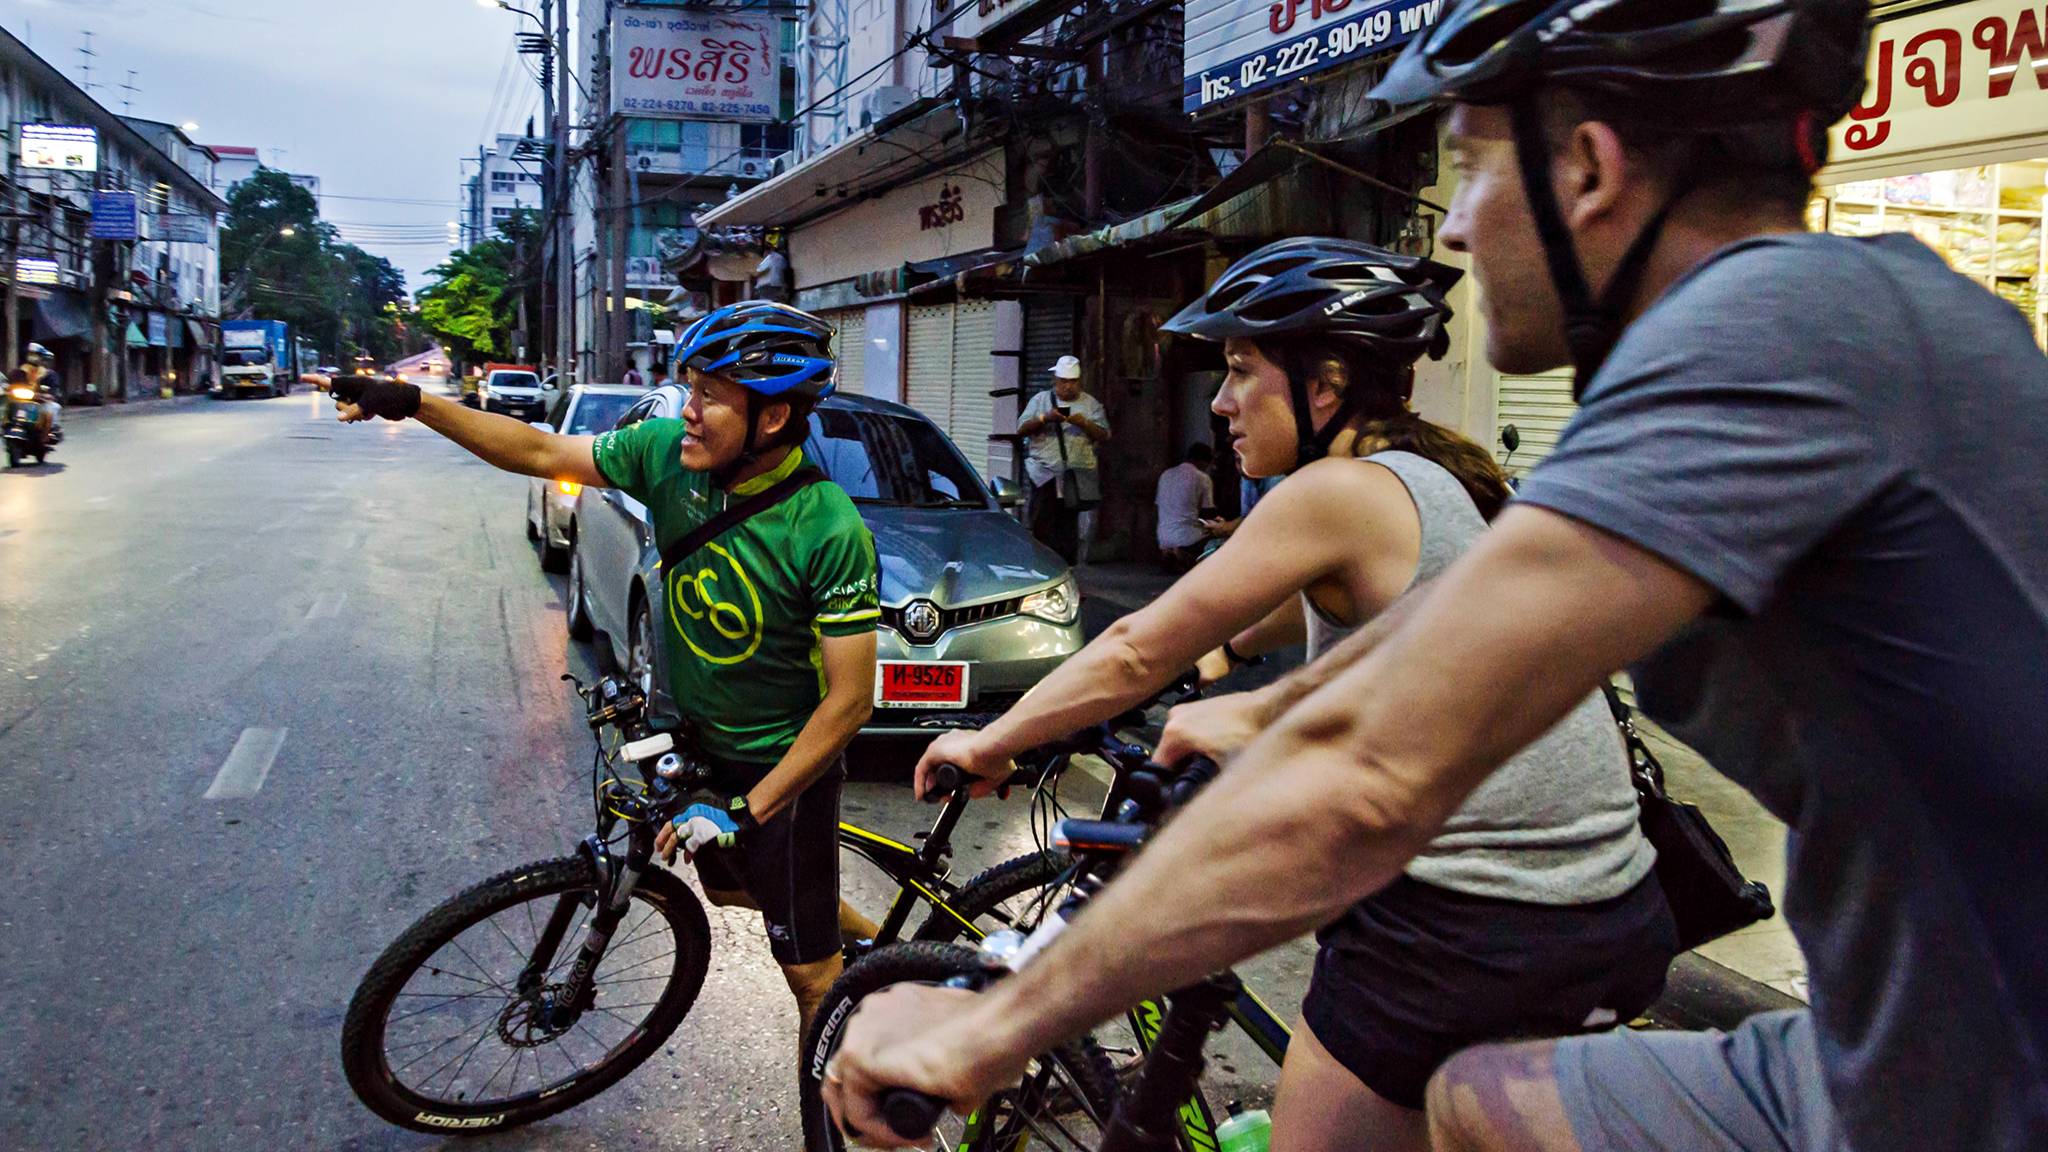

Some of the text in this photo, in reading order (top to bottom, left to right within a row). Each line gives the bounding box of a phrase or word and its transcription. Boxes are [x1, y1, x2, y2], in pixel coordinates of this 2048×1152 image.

[629, 38, 755, 84] พรสิริ
[1241, 10, 1392, 88] 02-222-9049
[812, 996, 853, 1080] MERIDA
[415, 1111, 505, 1129] MERIDA
